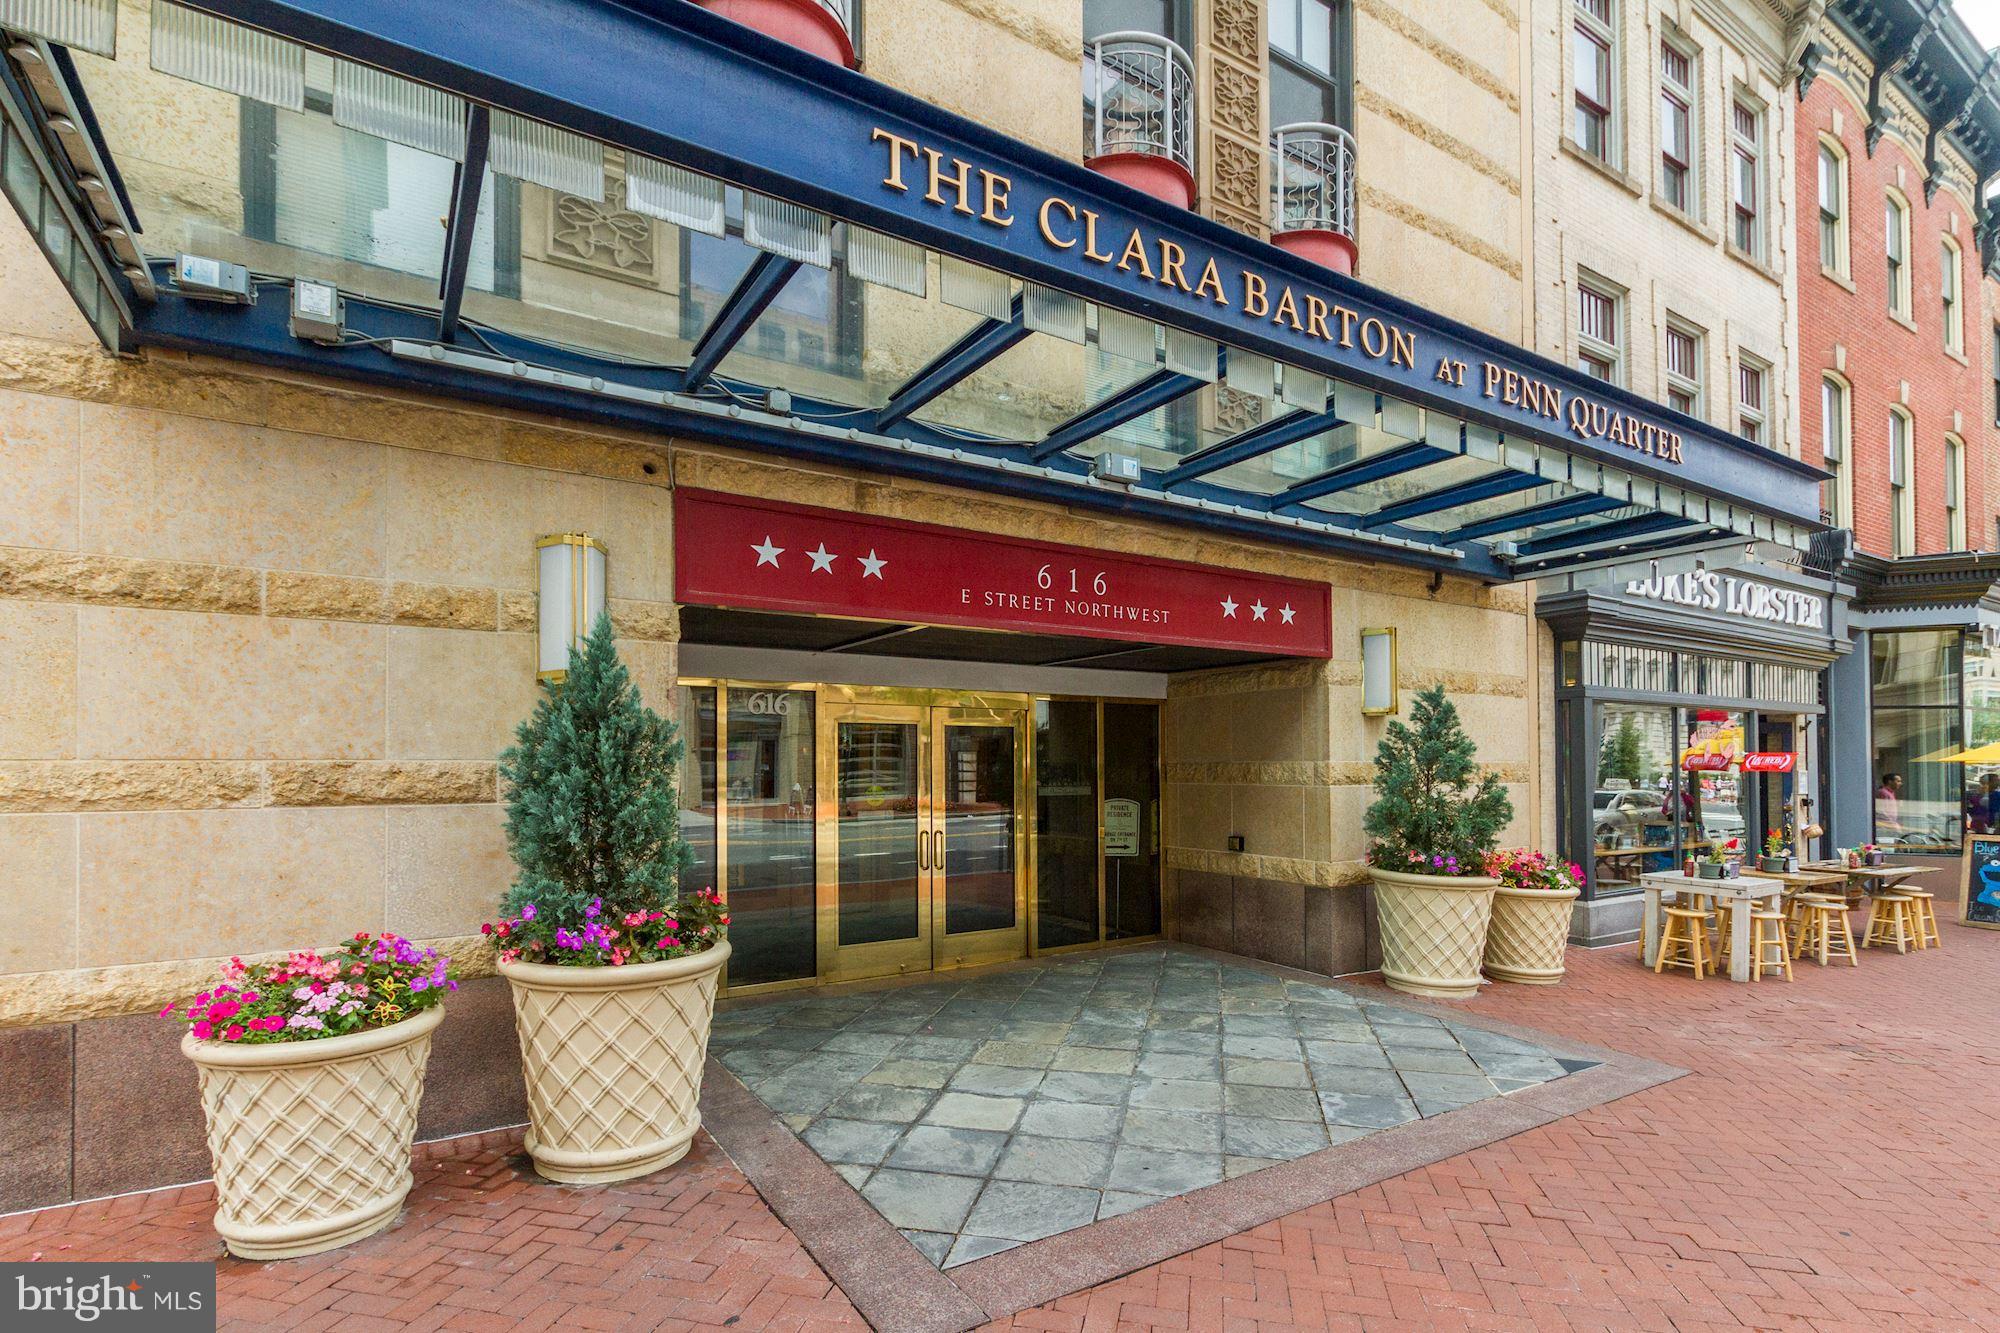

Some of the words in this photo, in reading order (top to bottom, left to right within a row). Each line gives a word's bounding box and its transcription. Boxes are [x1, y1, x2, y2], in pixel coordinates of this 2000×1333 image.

[872, 127, 1015, 228] THE
[1039, 197, 1230, 305] CLARA
[1242, 269, 1417, 370] BARTON
[1436, 356, 1467, 386] AT
[1483, 361, 1562, 421] PENN
[1568, 396, 1685, 465] QUARTER
[1037, 564, 1107, 596] 616
[961, 588, 971, 604] E
[984, 591, 1055, 612] STREET
[1065, 600, 1170, 624] NORTHWEST
[1725, 577, 1824, 629] LOBSTER
[748, 692, 791, 716] 616
[1974, 841, 2000, 855] Blue
